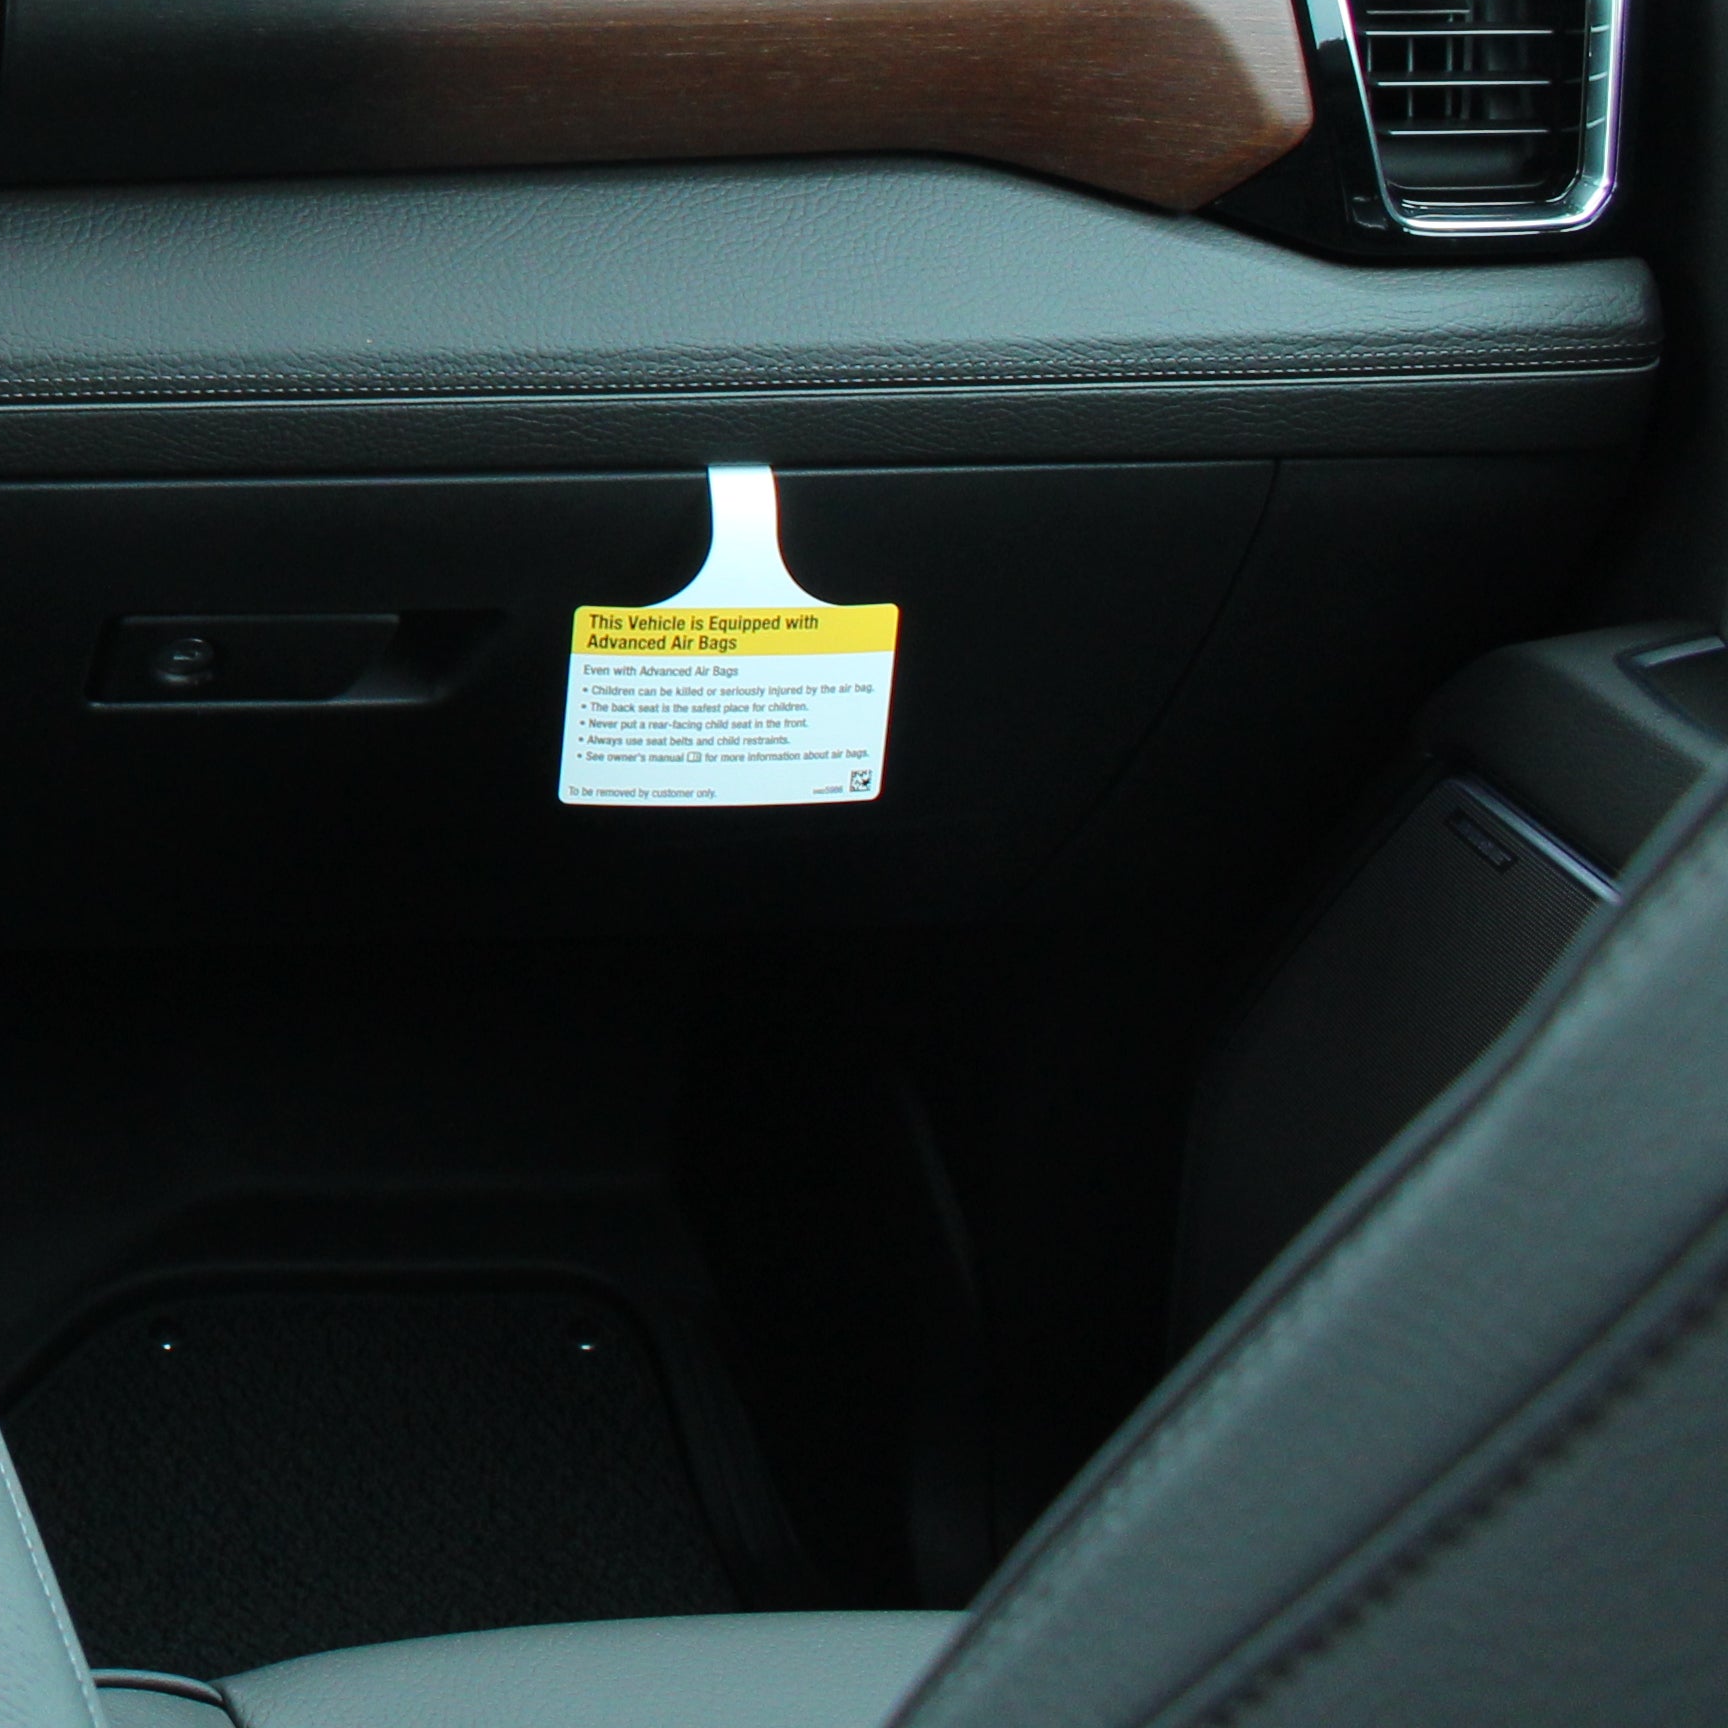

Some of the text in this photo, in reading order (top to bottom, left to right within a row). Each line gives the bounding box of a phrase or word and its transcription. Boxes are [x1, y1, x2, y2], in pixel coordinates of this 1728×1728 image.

[589, 613, 819, 634] This Vehicle is Equipped with
[586, 633, 738, 653] Advanced Air Bags
[583, 664, 739, 679] Even with Advanced Air Bags
[592, 683, 875, 698] Children can be killed or seriously injured by the air bag.
[590, 701, 809, 715] The back seat is the safest place for children.
[588, 718, 619, 729] Never
[620, 720, 637, 732] put
[648, 720, 703, 732] rear-facing
[705, 719, 729, 730] child
[731, 720, 752, 730] seat
[754, 719, 764, 729] in
[766, 719, 781, 729] the
[783, 718, 809, 729] front.
[586, 734, 791, 747] Always use seat belts and child restraints.
[585, 748, 870, 762] See owner's manual for more information about air bags.
[568, 786, 718, 800] To be removed by customer only.
